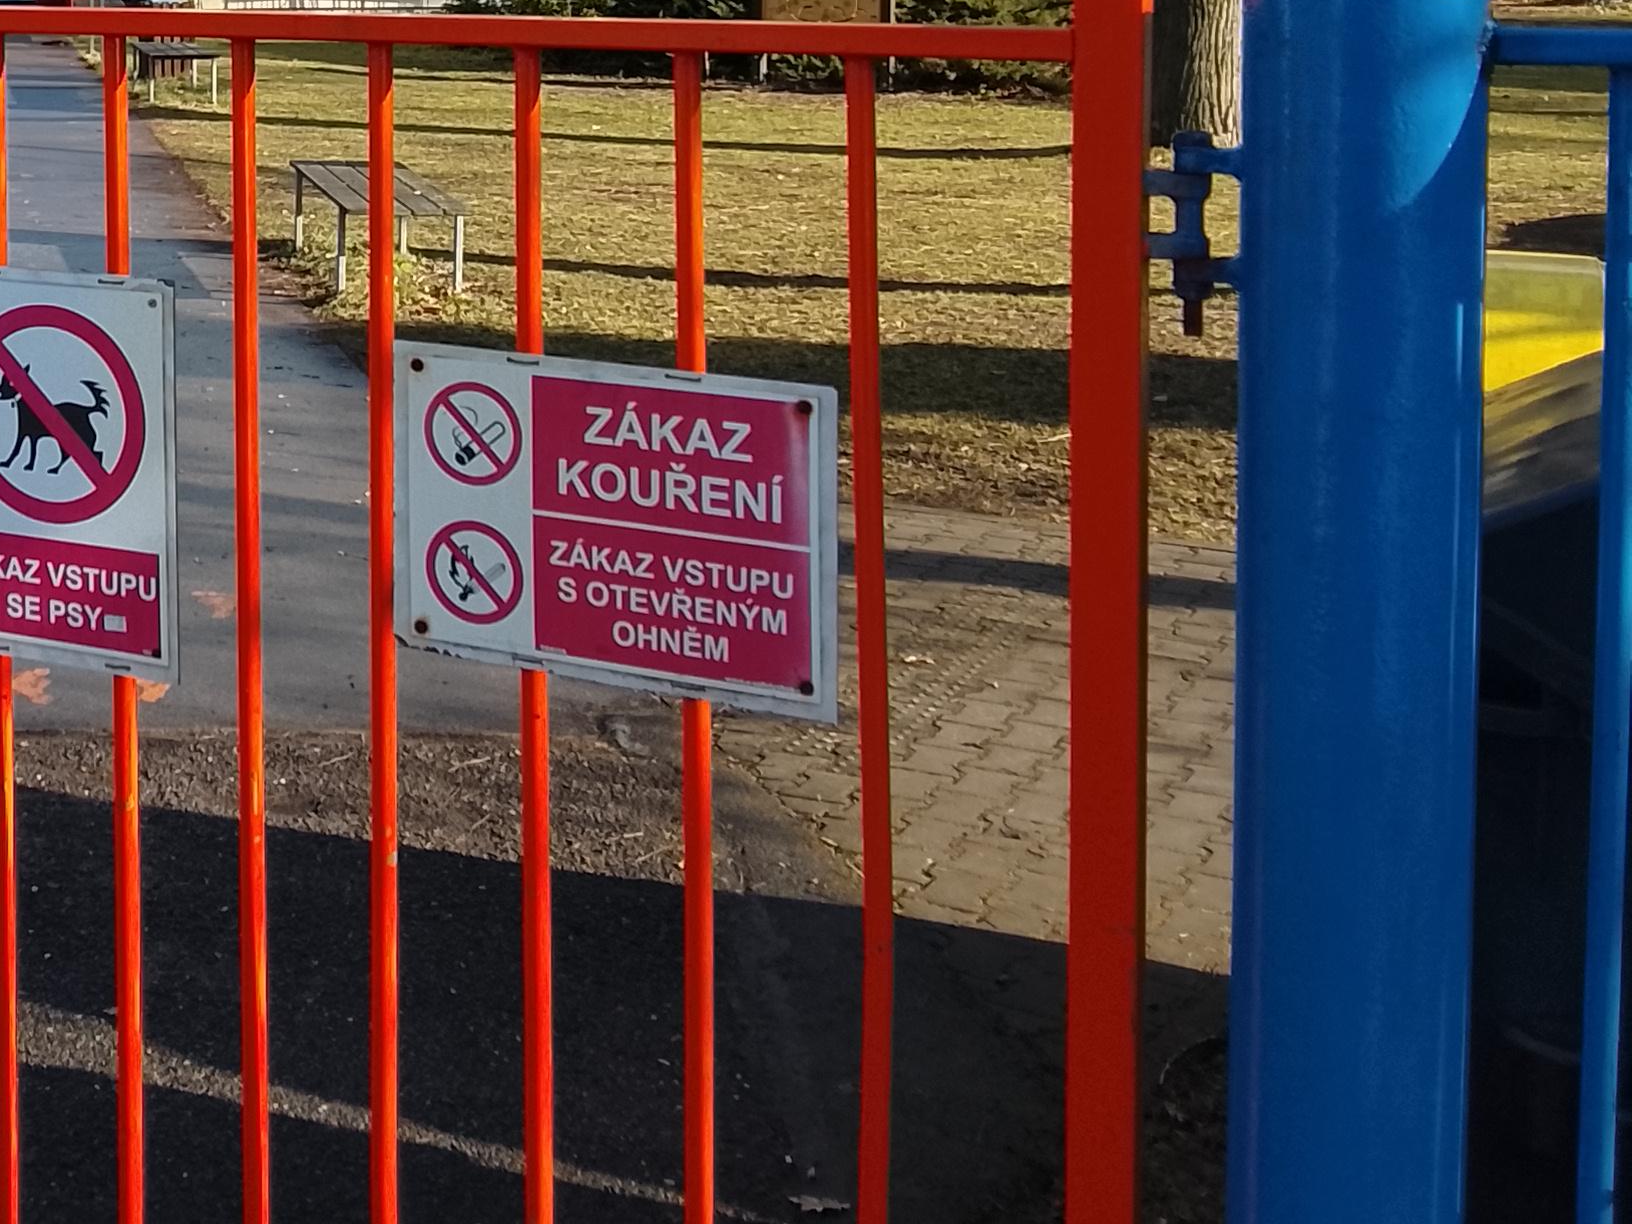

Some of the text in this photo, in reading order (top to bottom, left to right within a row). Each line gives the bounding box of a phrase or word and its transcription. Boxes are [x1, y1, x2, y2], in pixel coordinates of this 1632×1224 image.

[583, 401, 753, 463] ZÁKAZ
[557, 458, 783, 524] KOUŘENÍ
[47, 562, 157, 601] VSTUPU
[549, 538, 794, 599] ZÁKAZ VSTUPU
[7, 592, 103, 632] SE PSY
[558, 577, 788, 635] S OTEVŘENÝM
[612, 620, 729, 662] OHNĚM
